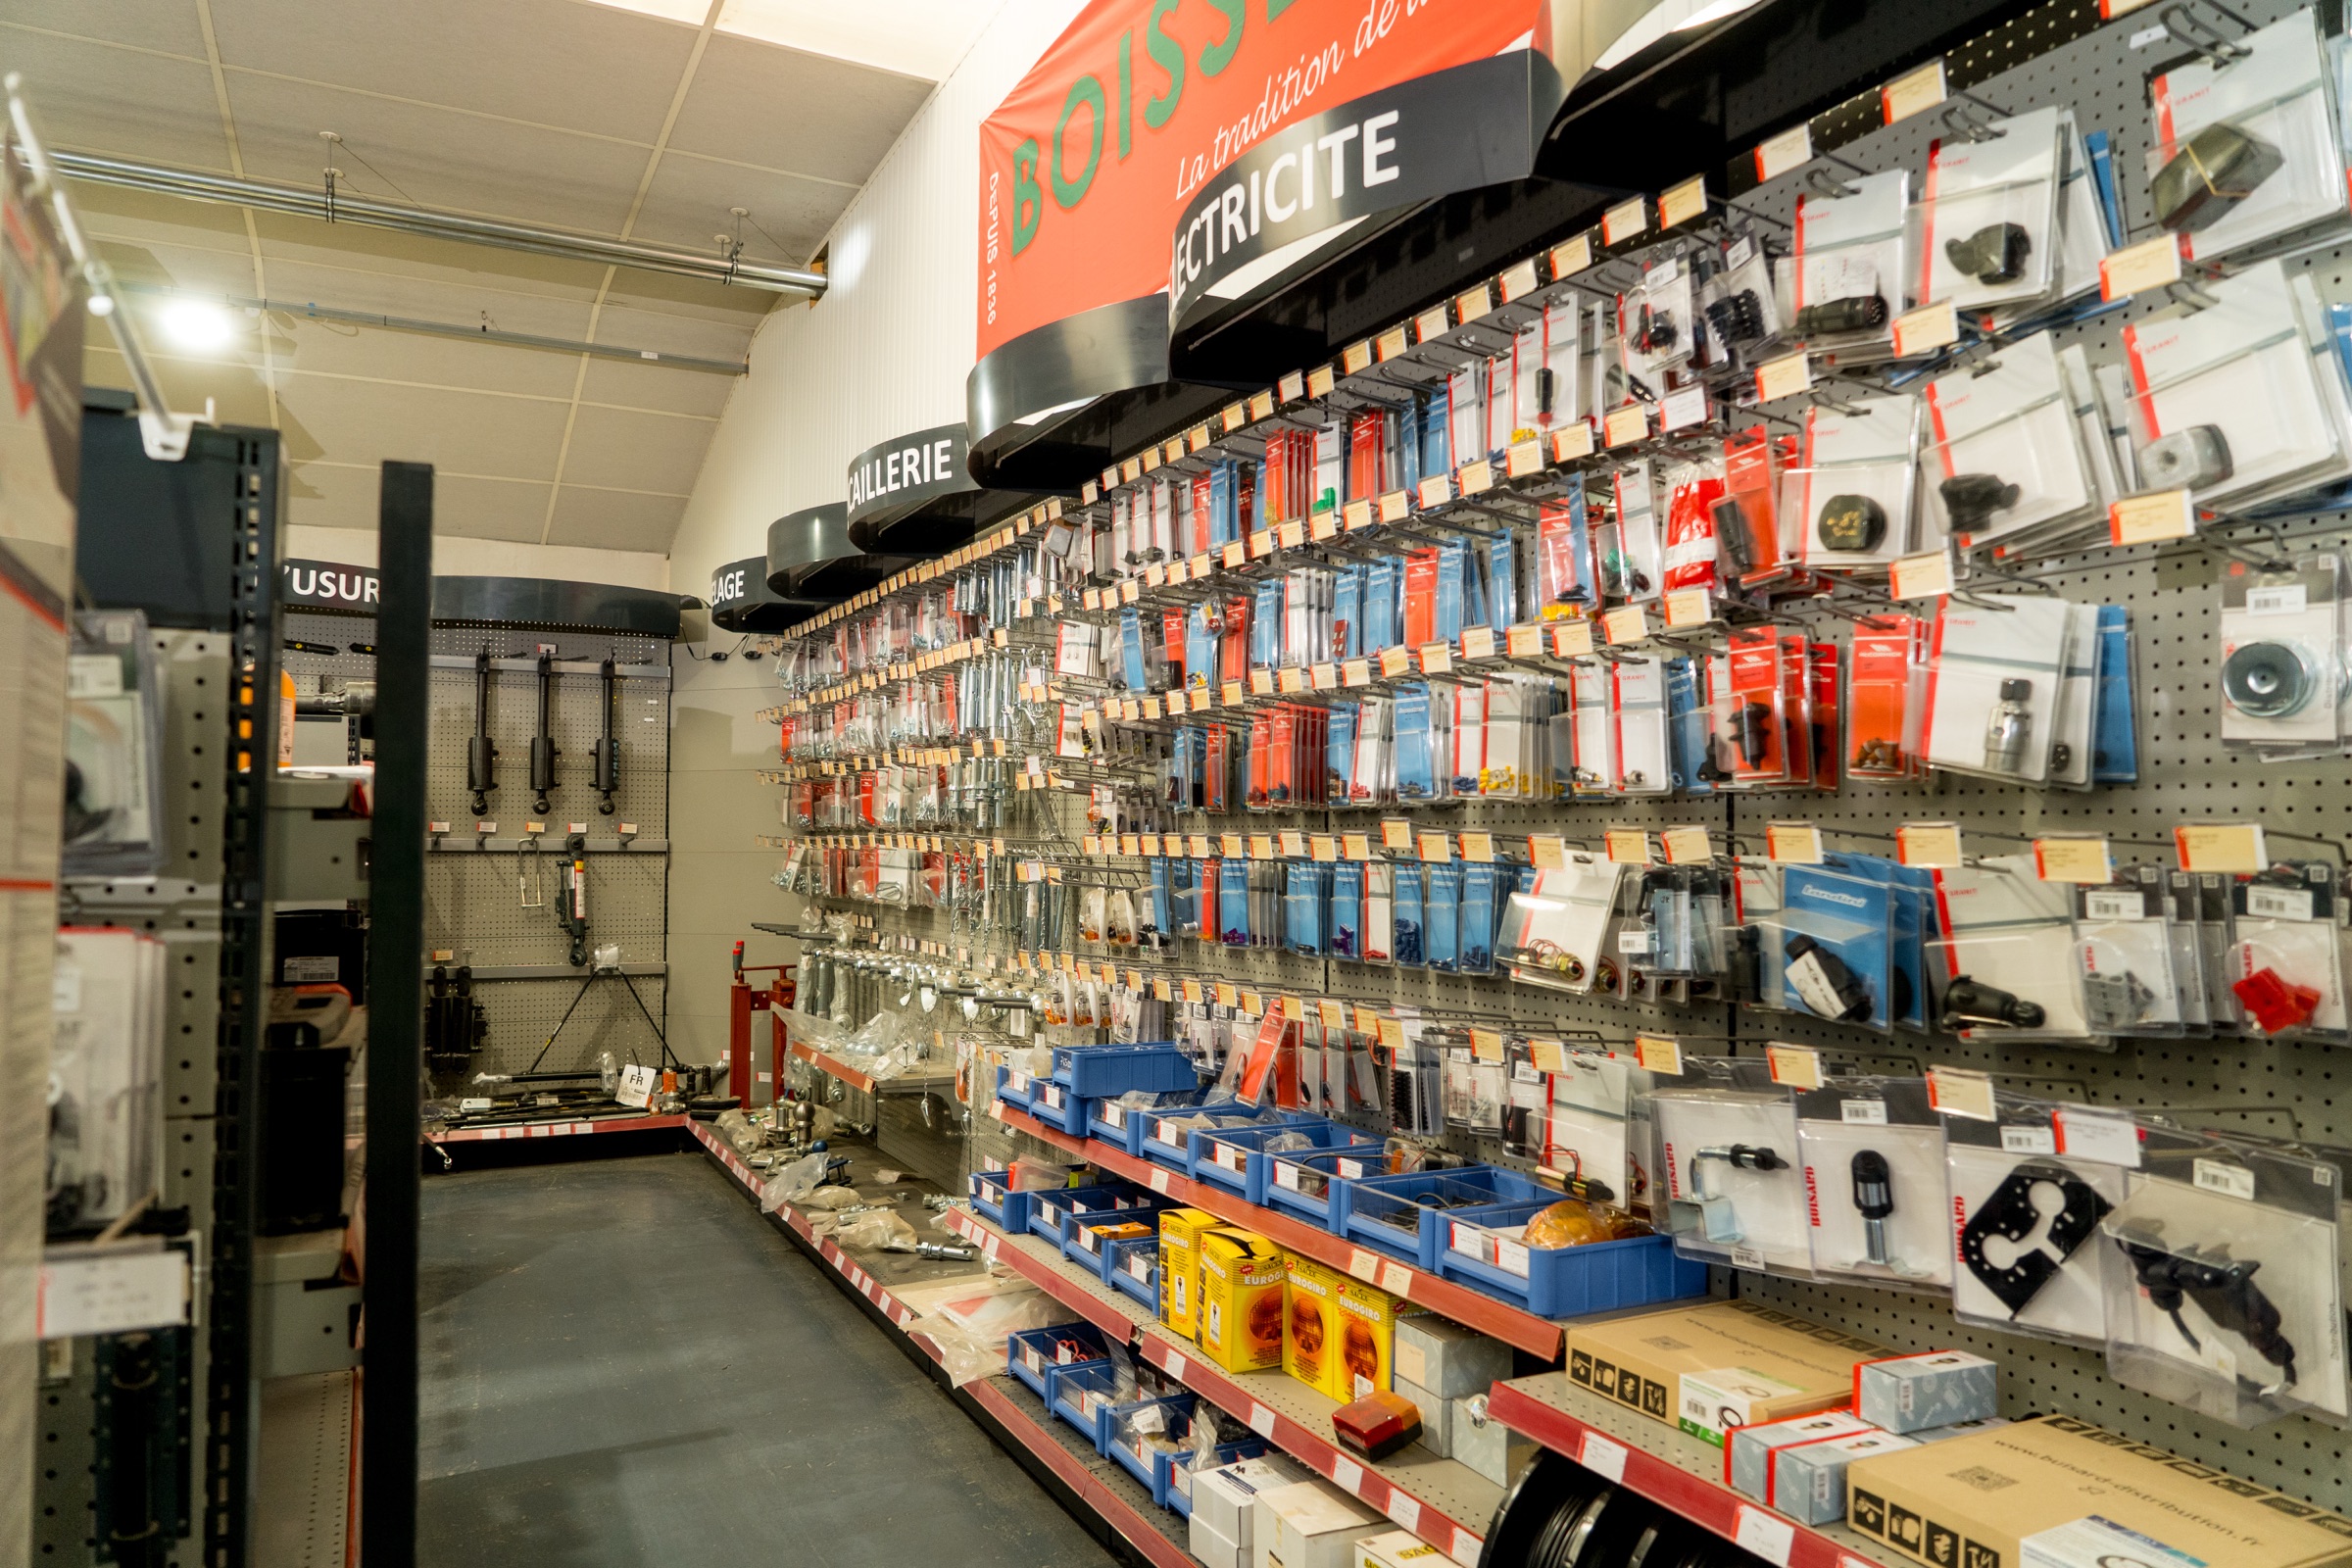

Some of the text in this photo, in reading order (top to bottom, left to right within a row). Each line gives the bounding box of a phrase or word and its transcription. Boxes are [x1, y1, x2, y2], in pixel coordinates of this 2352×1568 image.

[2175, 86, 2211, 106] GRANIT
[1012, 0, 1298, 258] BOISS
[1176, 157, 1209, 201] La
[1213, 41, 1346, 172] tradition
[987, 172, 999, 325] DEPUIS 1836
[629, 1074, 644, 1086] FR
[1804, 1165, 1822, 1227] BUISARD
[1162, 1232, 1189, 1250] EUROGIRO
[1201, 1252, 1226, 1279] EUROGIRO
[1287, 1272, 1327, 1297] EUROGIRO
[1339, 1296, 1380, 1322] EUROGIRO
